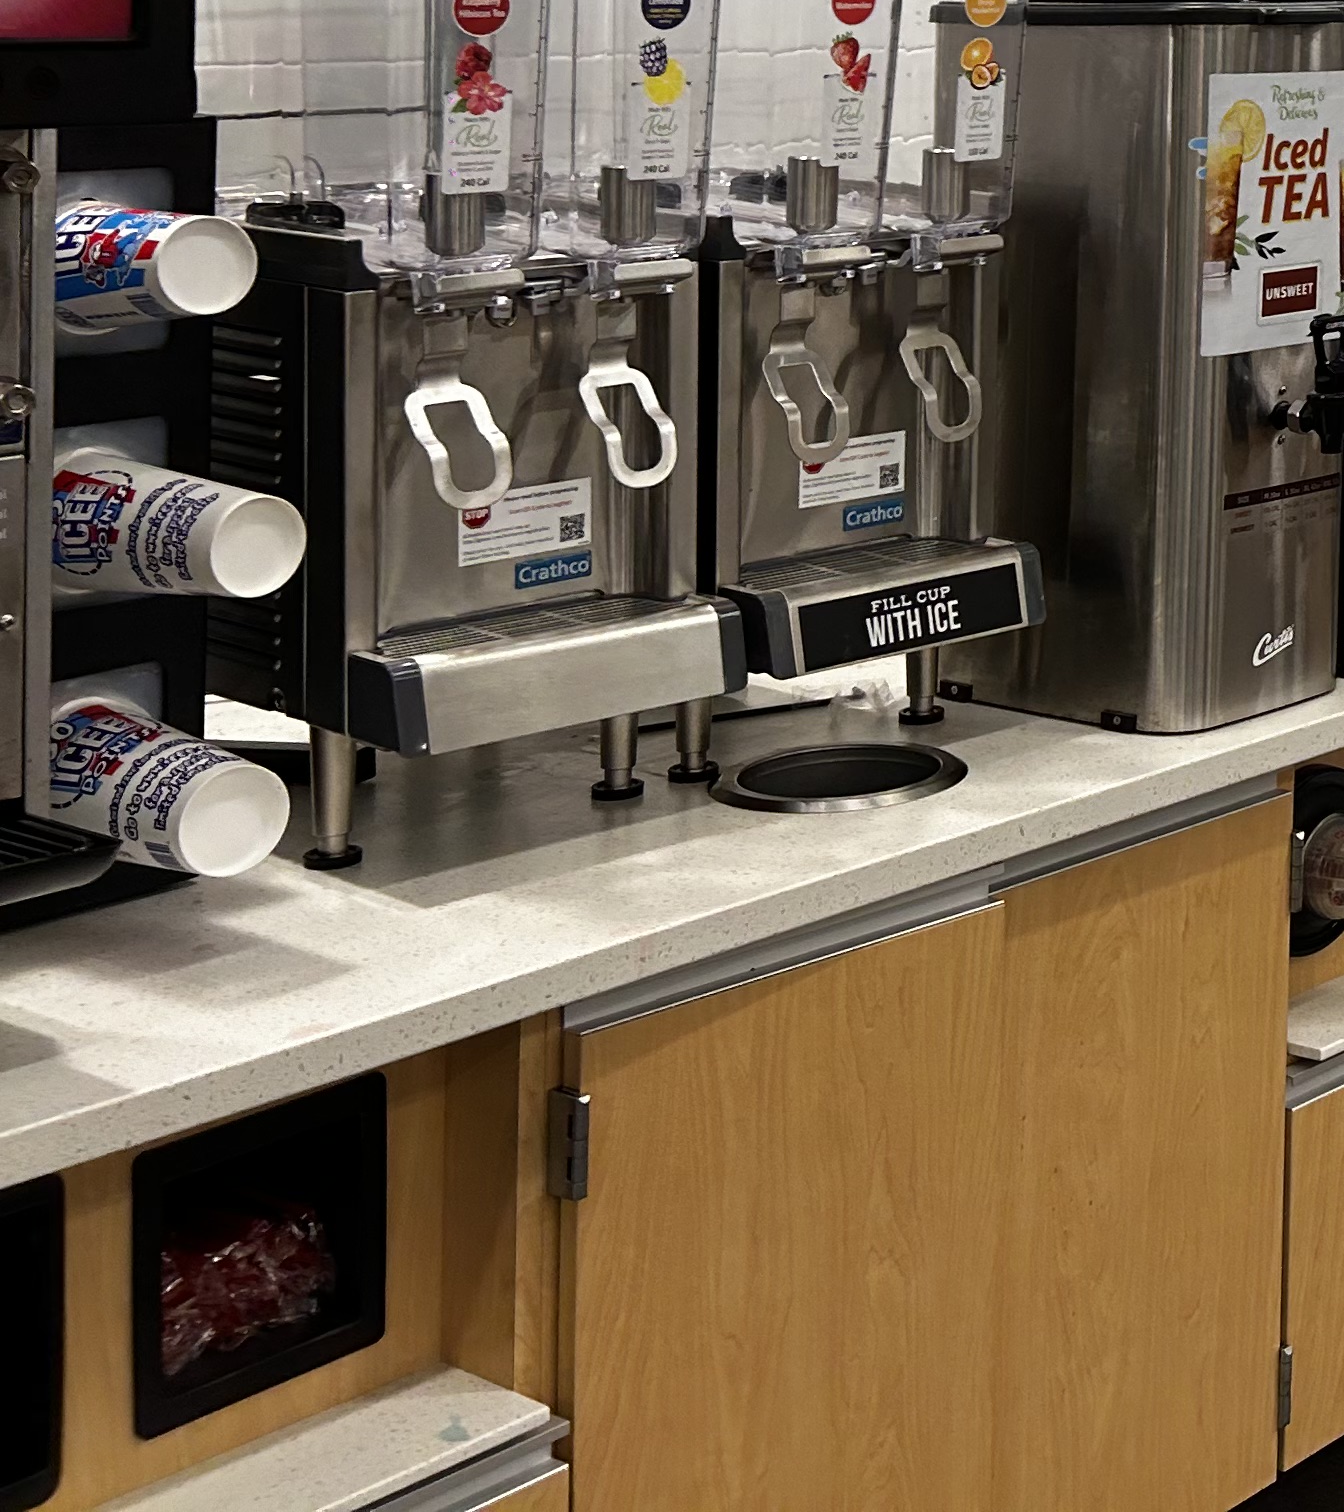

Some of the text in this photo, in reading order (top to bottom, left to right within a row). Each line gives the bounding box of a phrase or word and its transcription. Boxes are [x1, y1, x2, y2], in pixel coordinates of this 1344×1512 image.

[1271, 85, 1316, 105] Refreshing
[640, 110, 679, 137] Real
[831, 100, 865, 125] Real
[456, 120, 498, 148] Real
[1263, 128, 1330, 171] Iced
[1258, 172, 1330, 224] TEA
[1265, 281, 1314, 301] UNSWEET
[58, 482, 112, 565] ICEE
[97, 485, 132, 564] POINTS
[465, 508, 488, 521] STOP
[846, 505, 903, 526] Crathco
[146, 555, 160, 573] to
[519, 559, 589, 583] Crathco
[871, 586, 950, 613] FILL CUP
[865, 600, 961, 648] WITH ICE
[1253, 625, 1294, 667] Curtis
[50, 716, 138, 793] ICEE
[81, 726, 155, 796] POINTS
[144, 787, 164, 810] for
[124, 794, 142, 842] Go to
